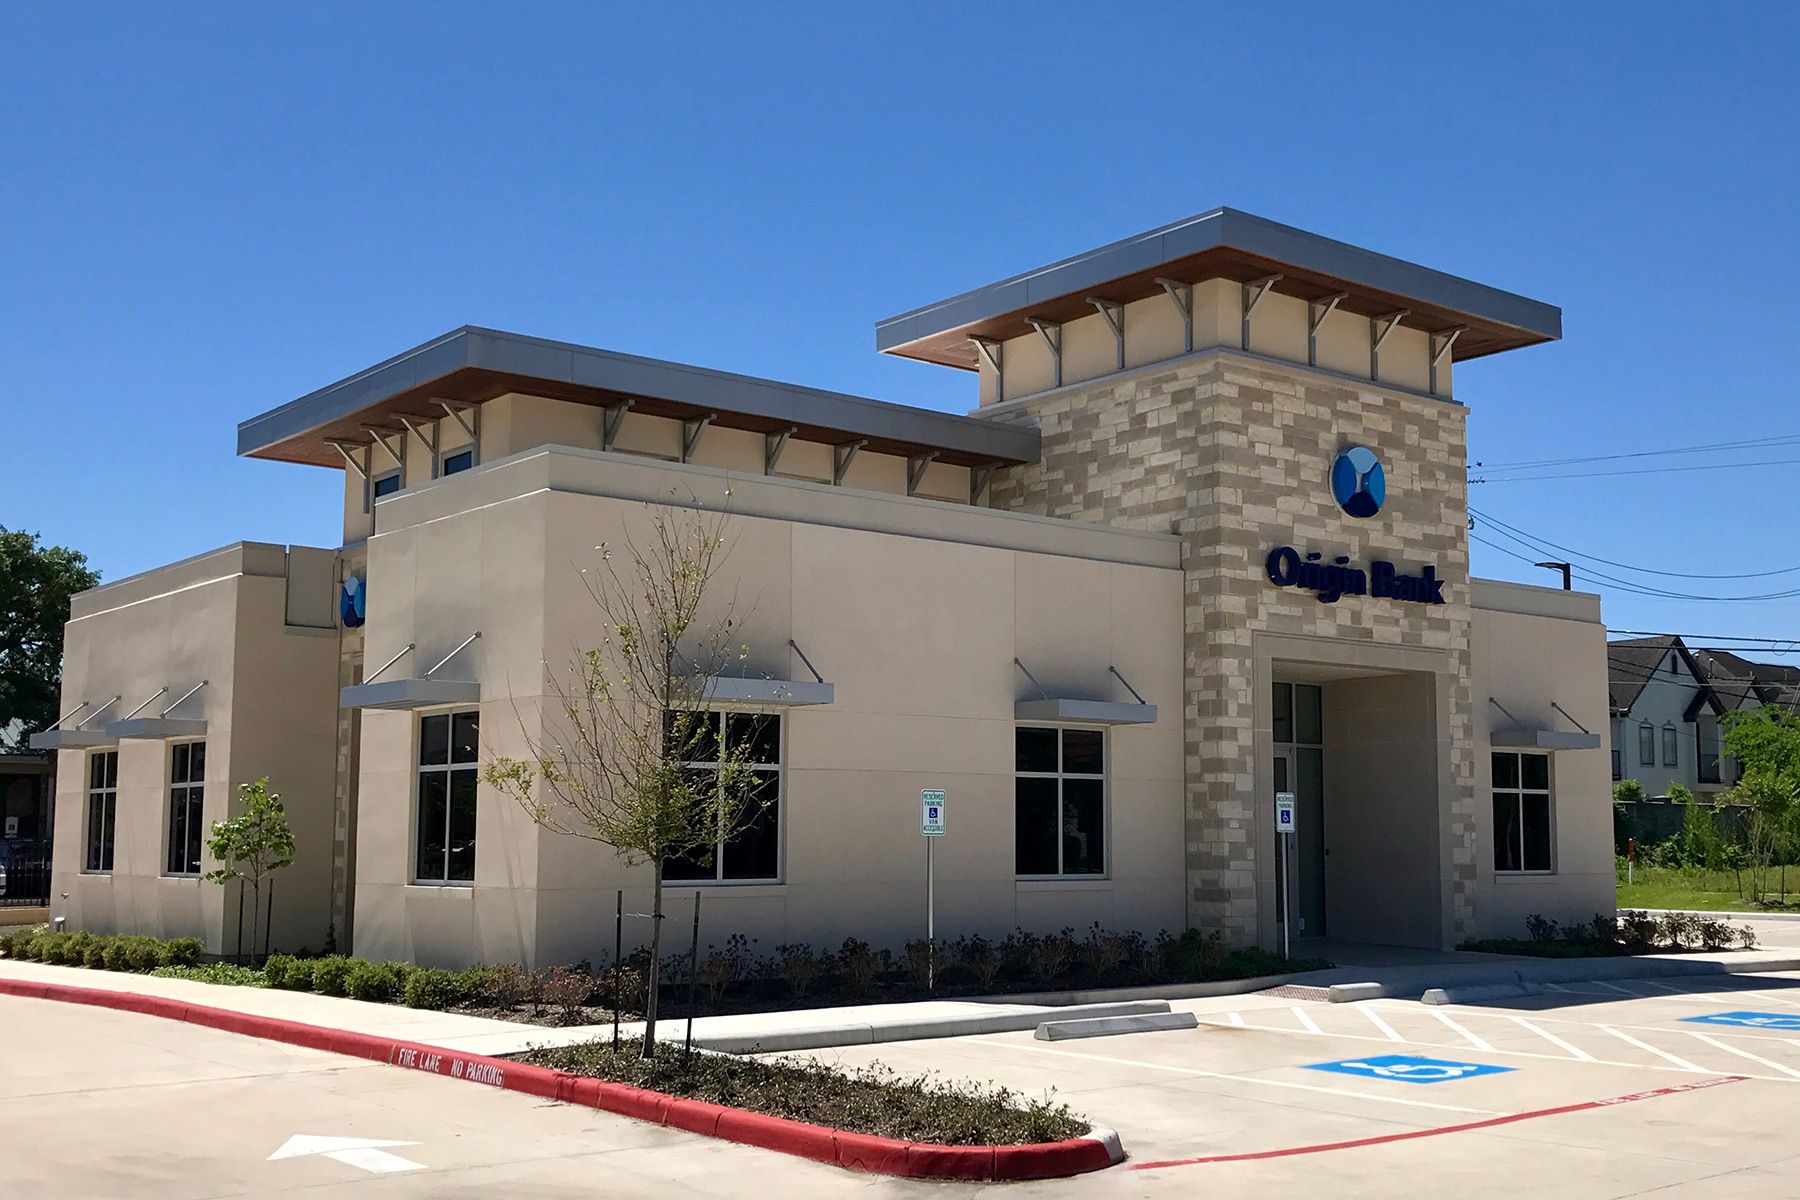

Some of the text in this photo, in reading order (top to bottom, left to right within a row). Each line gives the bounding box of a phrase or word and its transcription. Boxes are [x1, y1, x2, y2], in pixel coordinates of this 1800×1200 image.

[1267, 546, 1446, 604] Origin Bank
[398, 1048, 504, 1086] FIRE LANE NO PARKING
